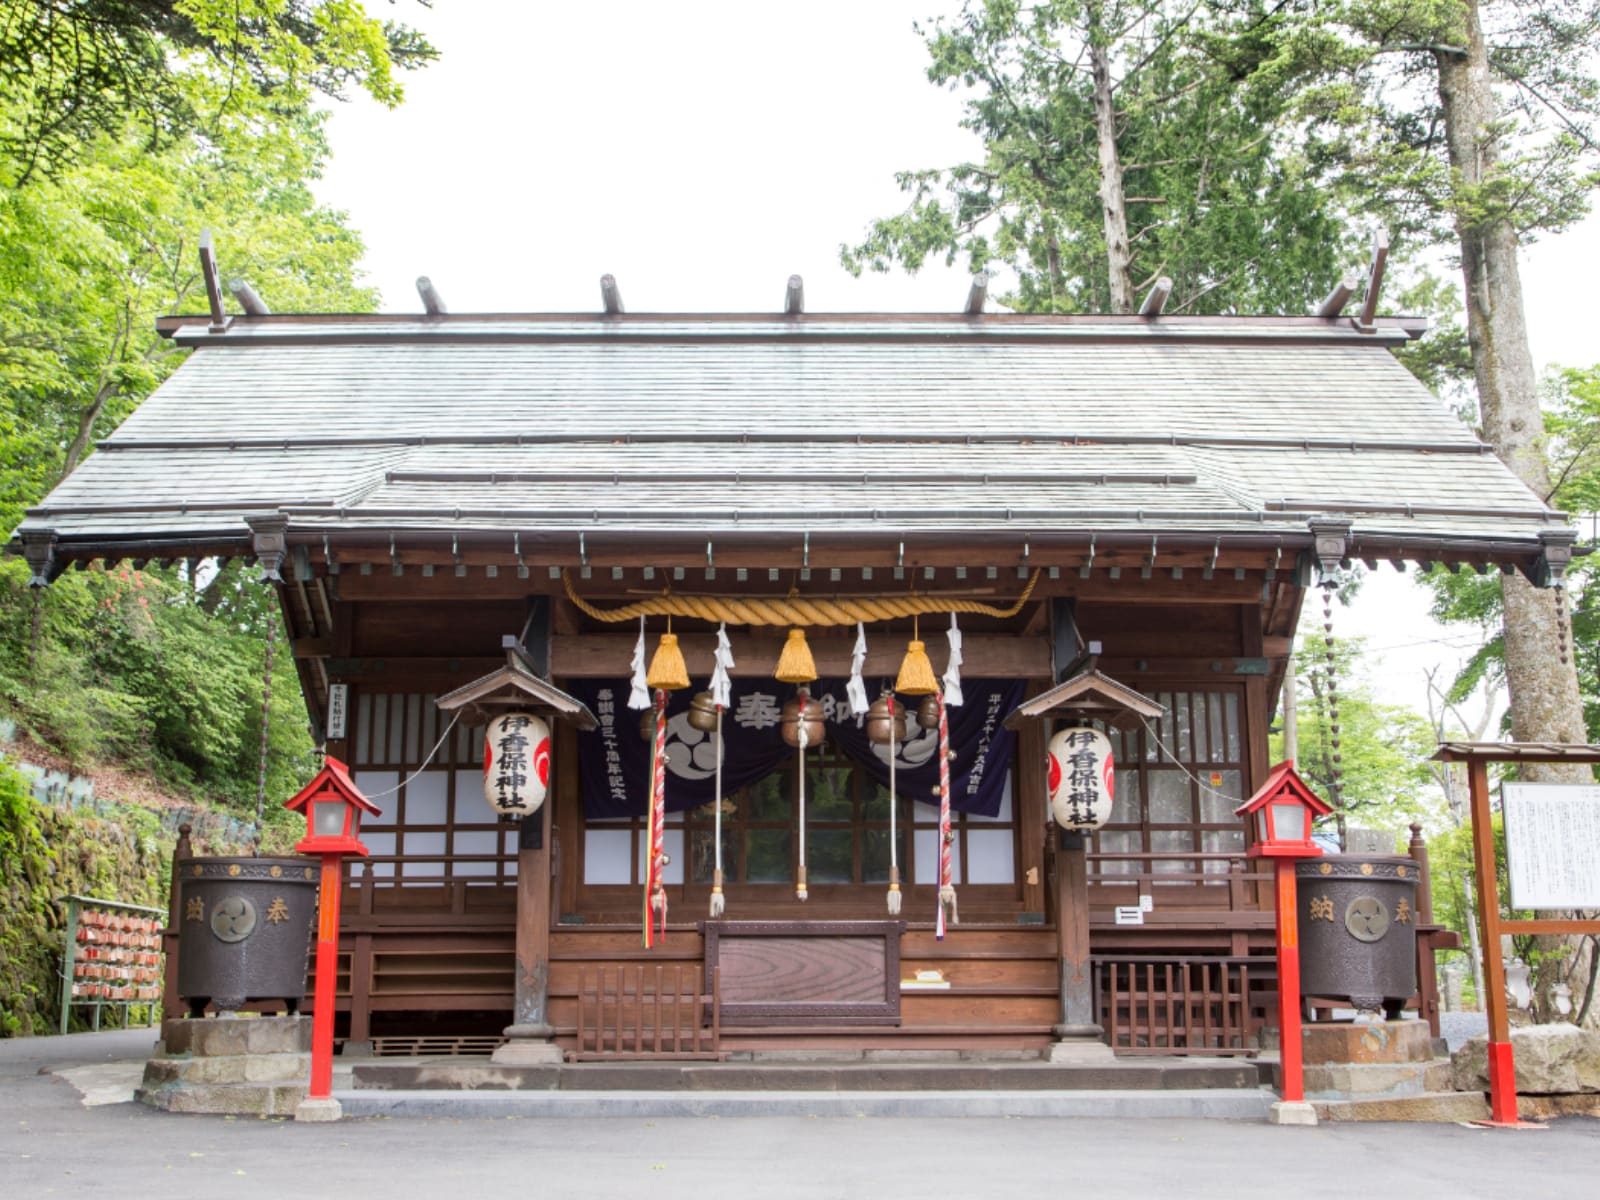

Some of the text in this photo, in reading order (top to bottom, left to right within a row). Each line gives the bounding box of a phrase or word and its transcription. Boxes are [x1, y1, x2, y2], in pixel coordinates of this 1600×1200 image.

[495, 716, 533, 809] 伊香保神社
[1065, 731, 1098, 825] 伊香保神社
